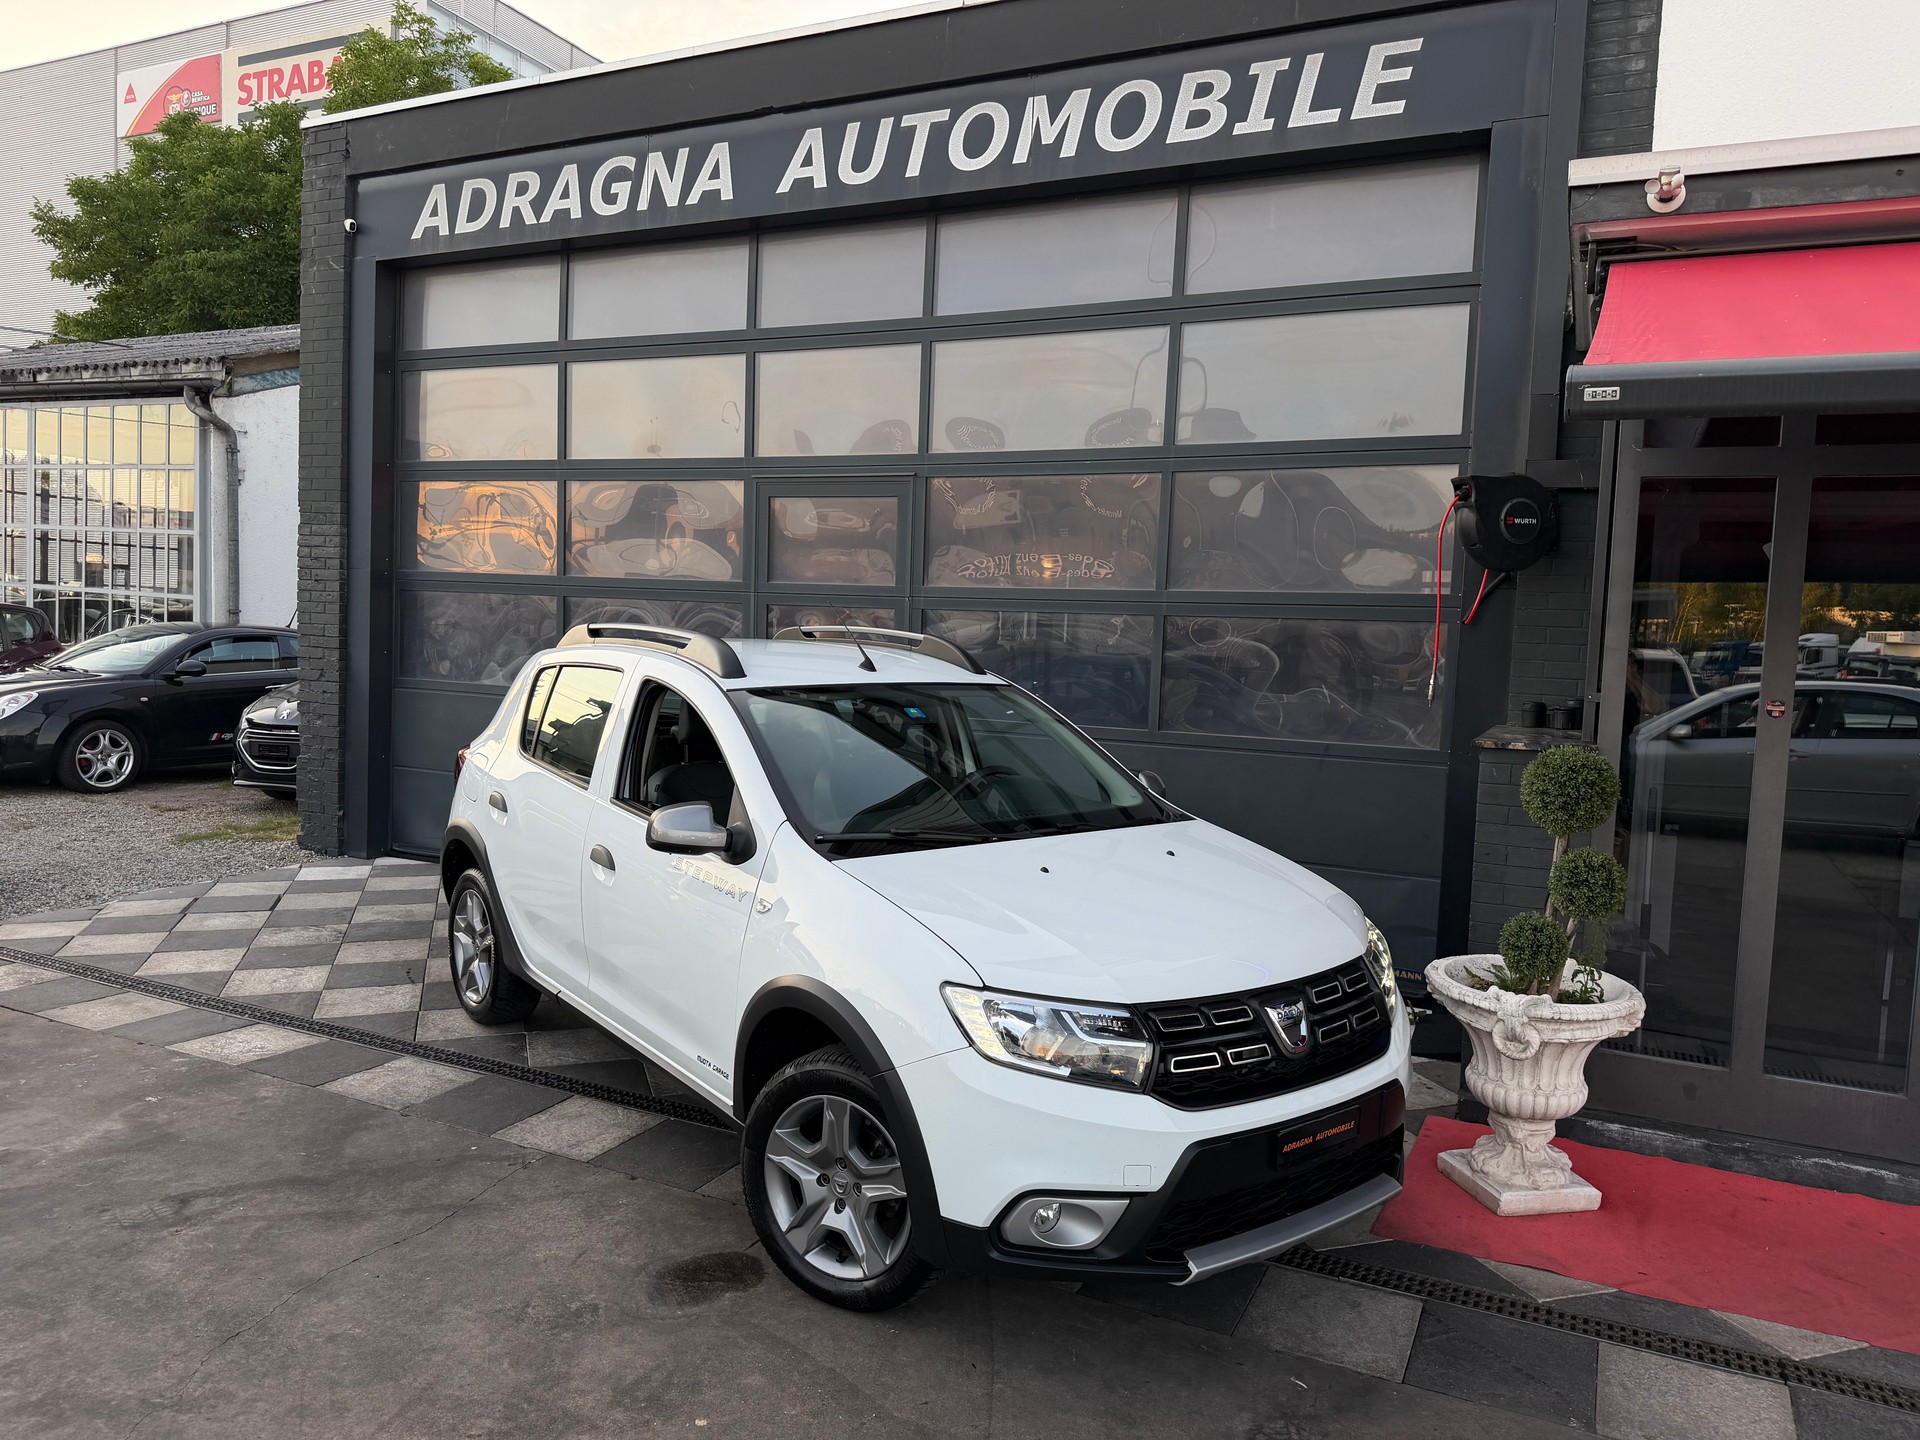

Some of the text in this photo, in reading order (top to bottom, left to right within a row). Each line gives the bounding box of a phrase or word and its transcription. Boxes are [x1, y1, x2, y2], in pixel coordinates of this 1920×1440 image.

[237, 56, 343, 105] STRAB
[411, 37, 1424, 240] ADRAGNA AUTOMOBILE
[673, 856, 749, 903] STEPWAY
[1282, 1120, 1356, 1154] ADRAGNA AUTOMOBILE
